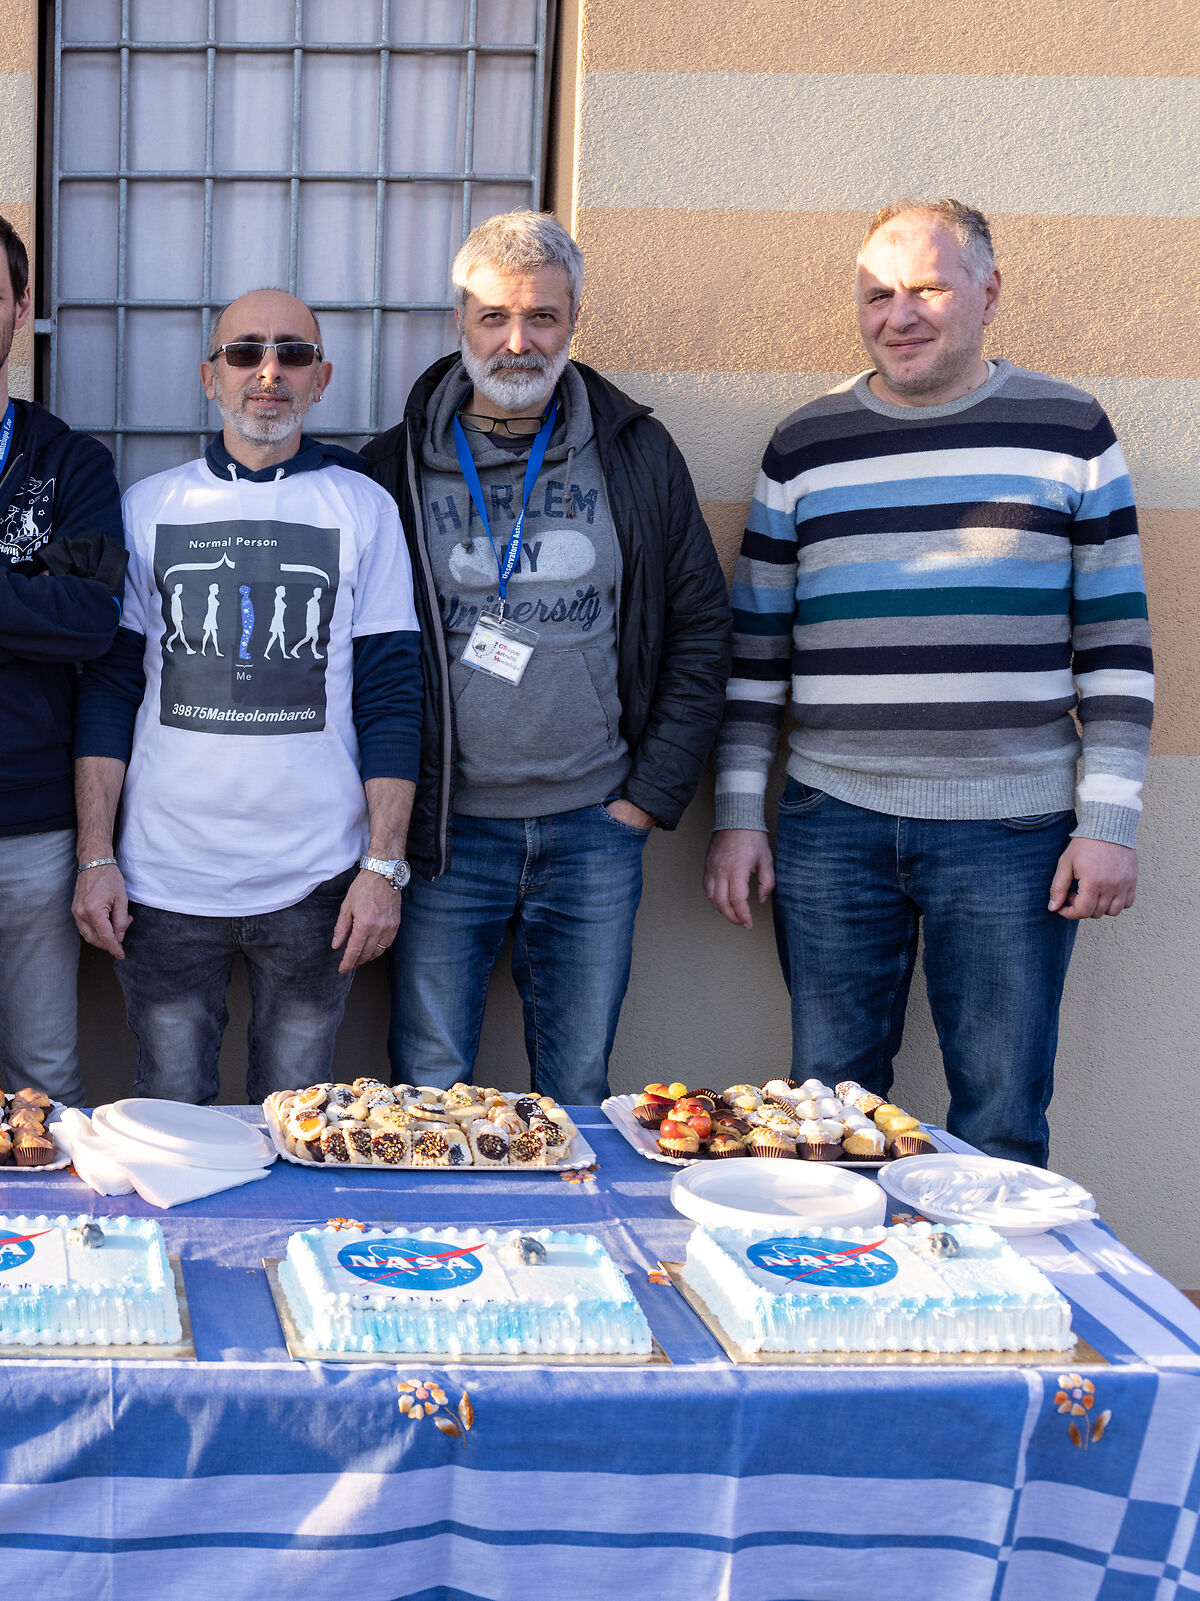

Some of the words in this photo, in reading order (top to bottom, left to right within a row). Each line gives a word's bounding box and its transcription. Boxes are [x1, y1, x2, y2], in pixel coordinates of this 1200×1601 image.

[188, 537, 232, 549] Normal
[236, 536, 278, 547] Person
[502, 539, 519, 579] Osservatorio
[236, 671, 252, 681] Me
[172, 702, 317, 723] 39875Matteolombardo
[349, 1254, 476, 1270] NASA
[758, 1252, 890, 1268] NASA
